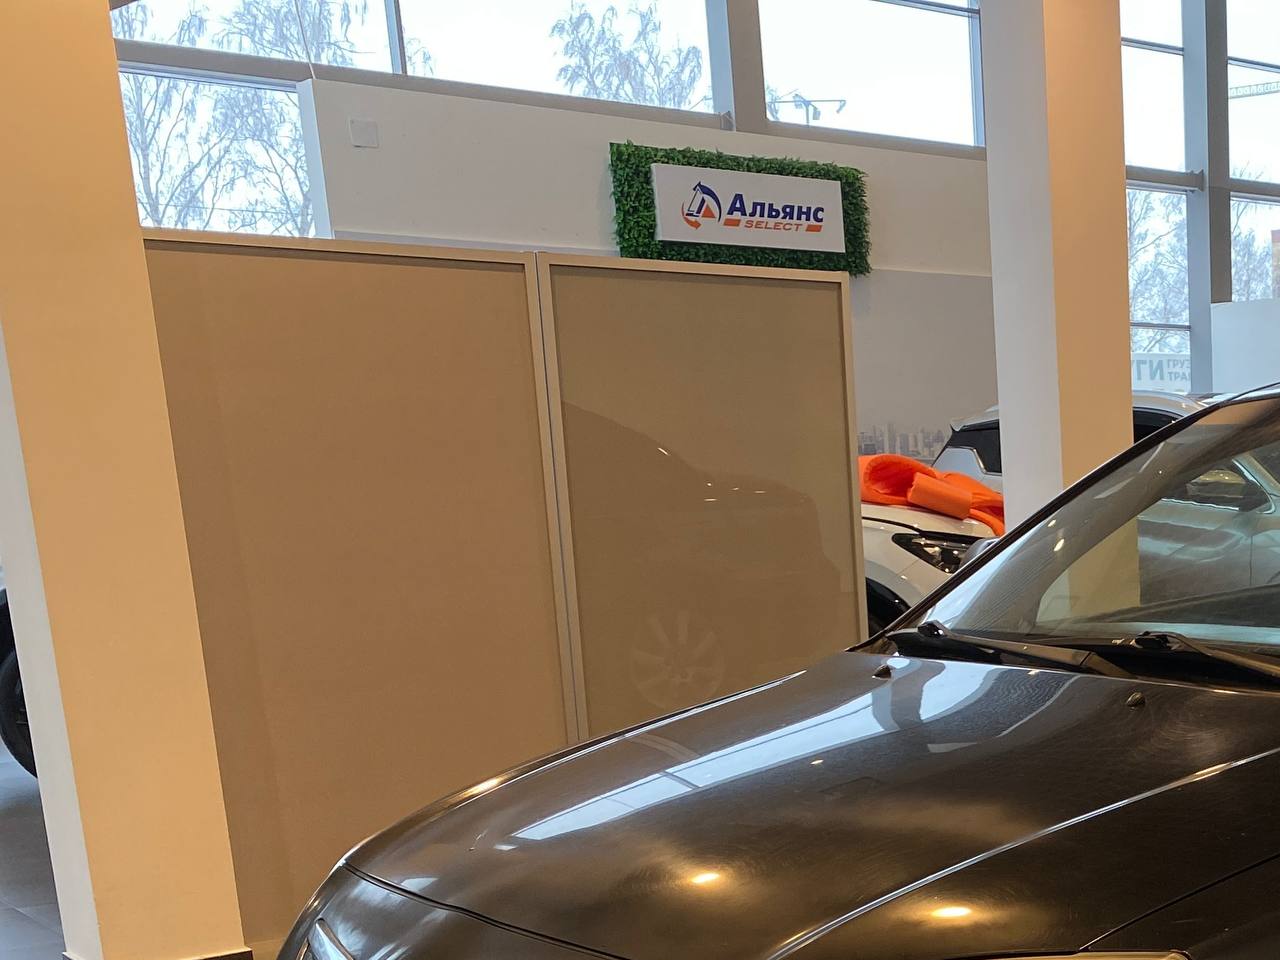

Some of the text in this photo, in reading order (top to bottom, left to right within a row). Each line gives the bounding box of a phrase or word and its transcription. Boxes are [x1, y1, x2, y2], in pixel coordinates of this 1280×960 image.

[727, 193, 824, 223] Альянс
[744, 219, 802, 232] SELECT
[1133, 359, 1164, 381] ГИ
[1167, 371, 1190, 382] ТРА
